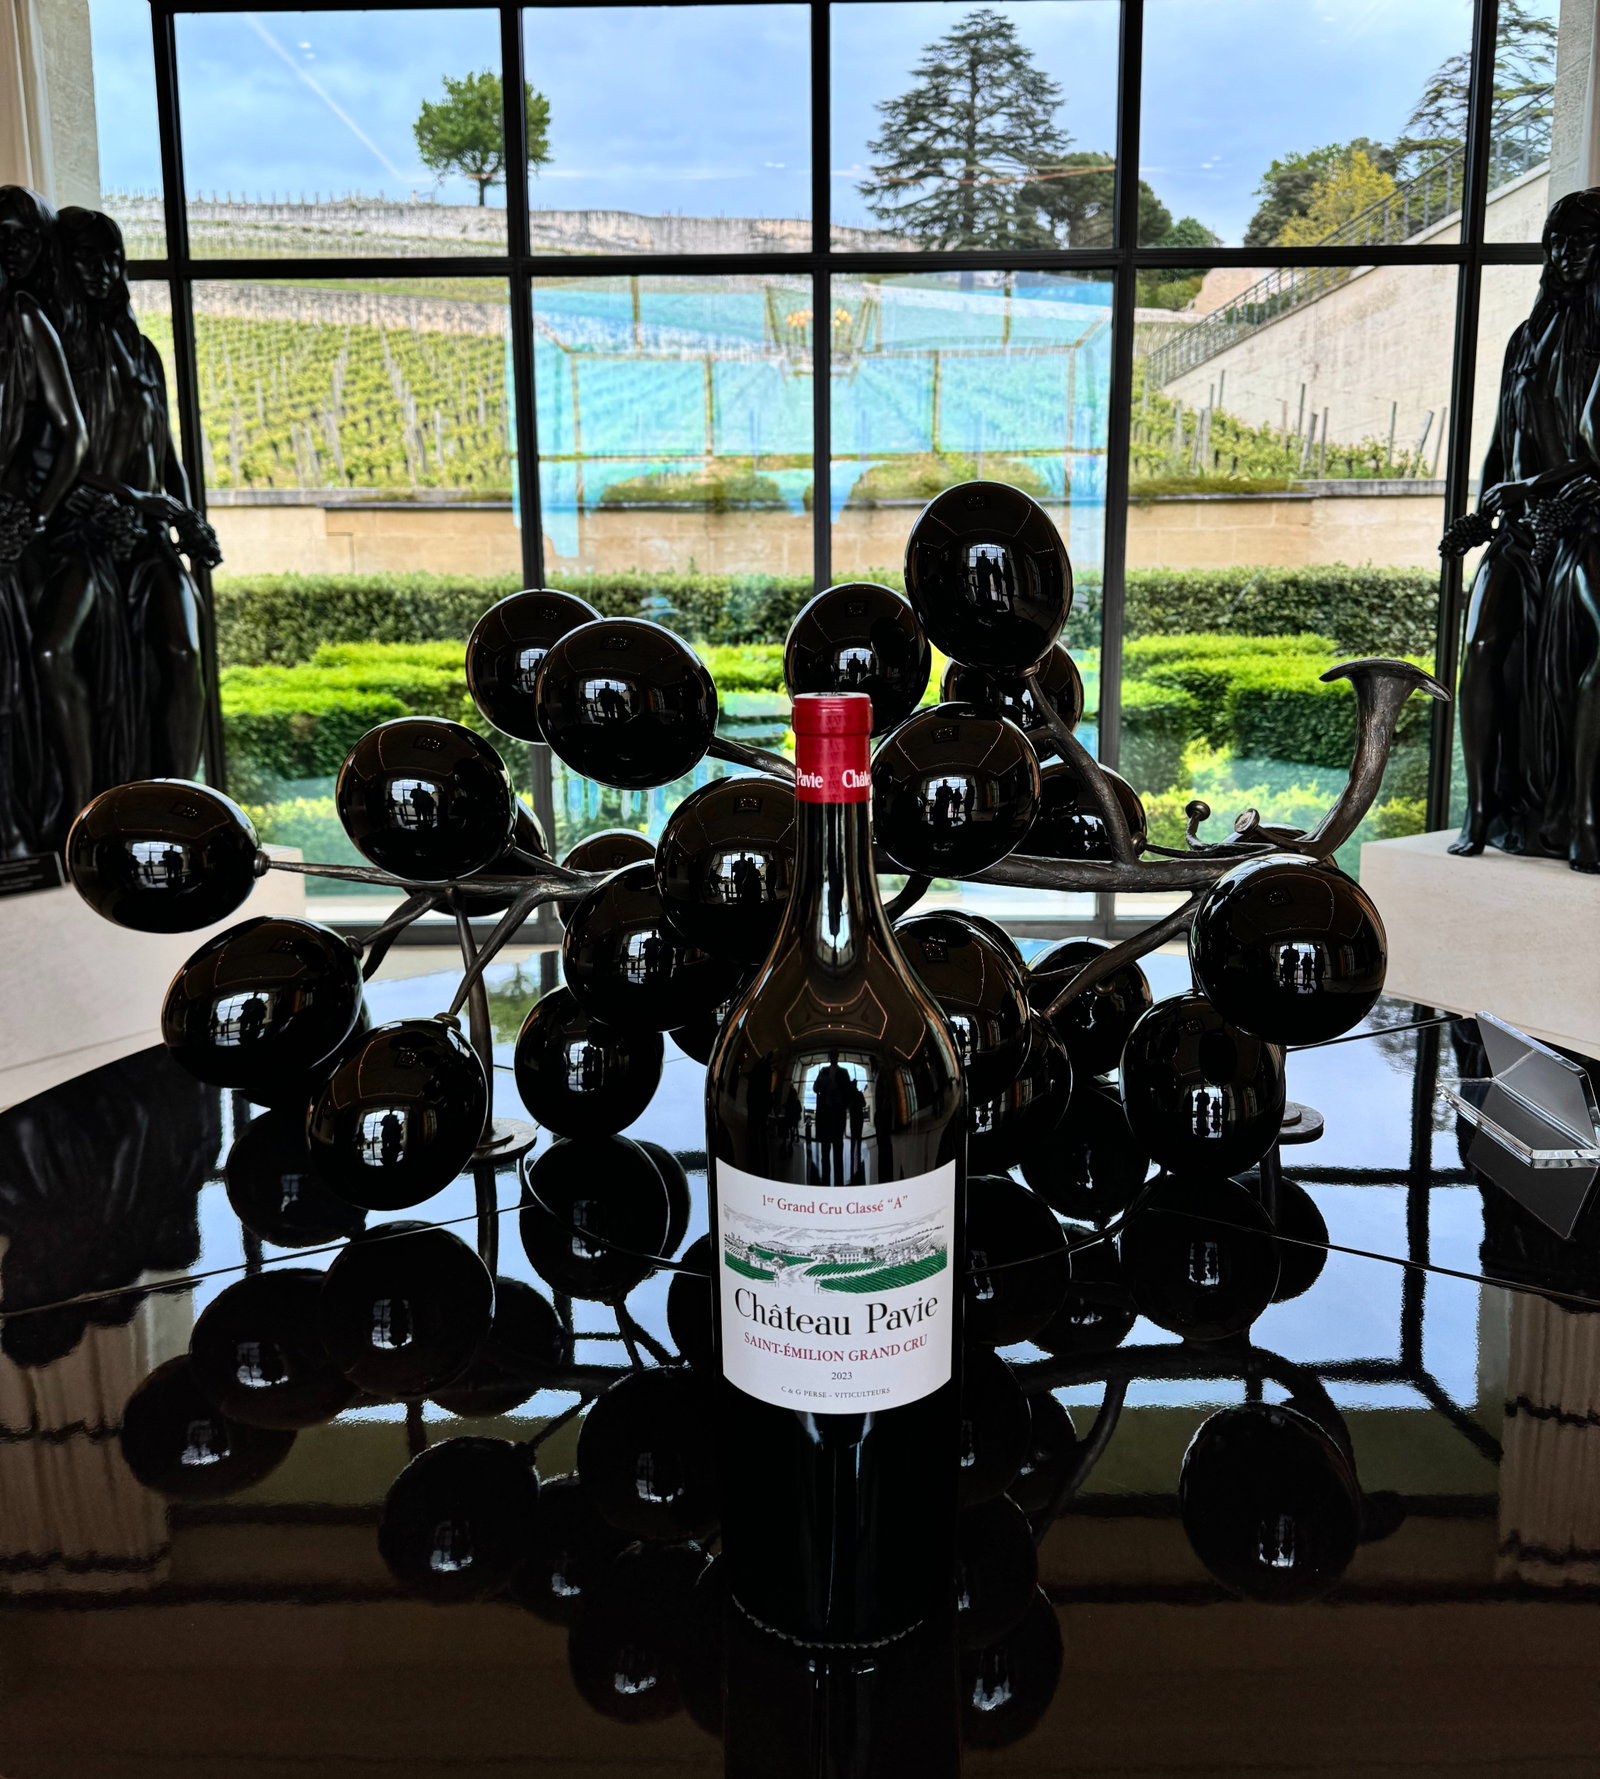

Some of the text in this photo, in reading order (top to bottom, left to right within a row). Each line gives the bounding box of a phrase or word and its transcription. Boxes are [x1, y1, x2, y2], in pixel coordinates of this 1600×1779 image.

[796, 768, 824, 788] Pavie
[762, 1194, 775, 1206] 1er
[777, 1197, 815, 1214] Grand
[819, 1202, 842, 1215] Cru
[846, 1200, 884, 1214] Classé
[735, 1287, 938, 1336] Château Pavie
[744, 1331, 928, 1363] SAINT-ÉMILION GRAND CRU
[831, 1371, 853, 1381] 2023
[780, 1385, 787, 1393] C
[803, 1389, 828, 1399] PERSE
[834, 1387, 891, 1399] VITICULTEURS
